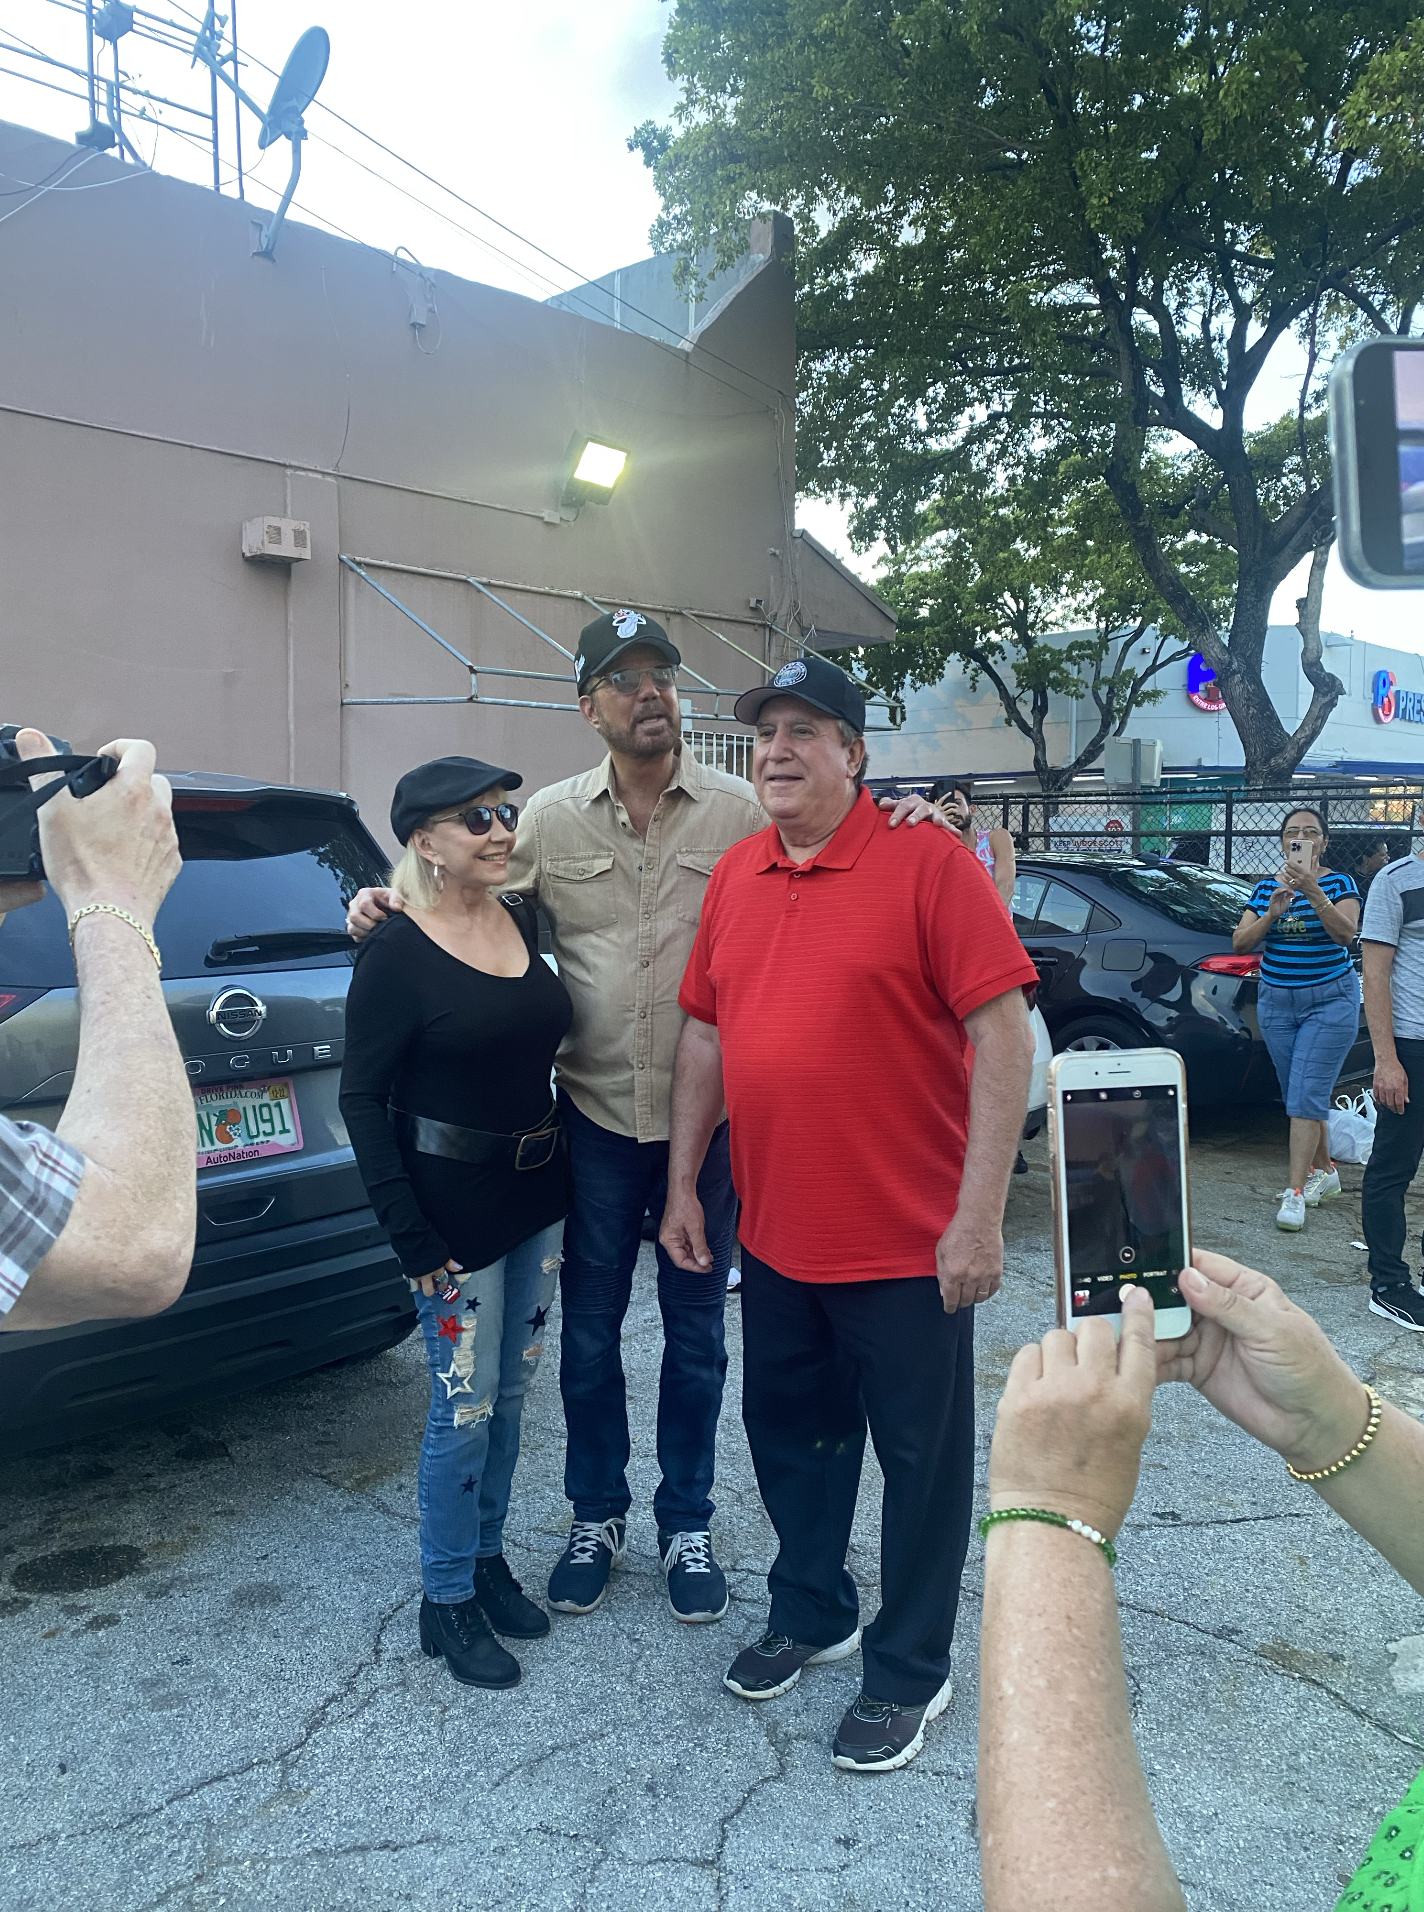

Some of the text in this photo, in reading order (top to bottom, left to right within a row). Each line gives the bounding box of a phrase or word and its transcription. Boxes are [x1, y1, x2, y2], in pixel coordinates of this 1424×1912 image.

[1073, 839, 1097, 847] JUDGE
[1098, 839, 1122, 847] SCOTT
[216, 1009, 262, 1020] NISSAN
[201, 1084, 244, 1095] DRIVE PINK
[196, 1090, 265, 1106] FLORIDA.COM
[242, 1101, 291, 1140] U91
[205, 1149, 260, 1165] AutoNation
